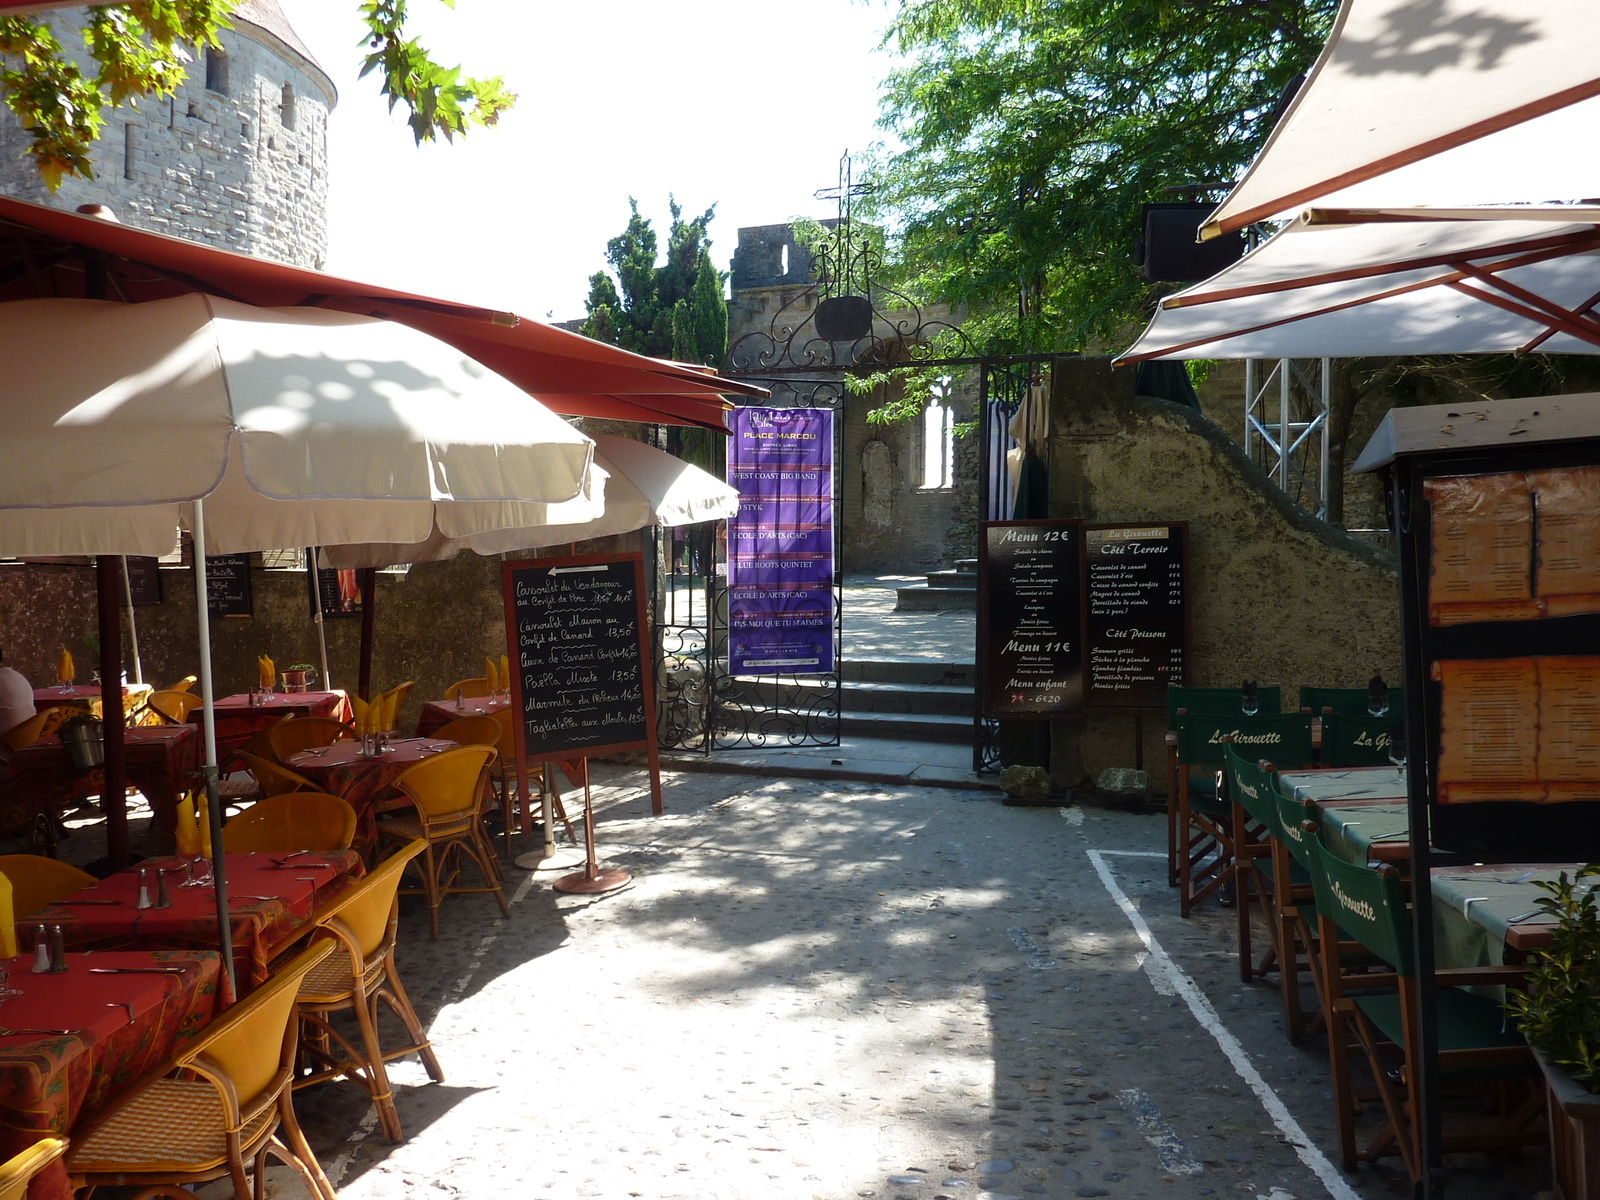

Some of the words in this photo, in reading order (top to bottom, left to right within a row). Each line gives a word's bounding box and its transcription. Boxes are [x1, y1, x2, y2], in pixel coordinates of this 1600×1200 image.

[787, 532, 807, 540] (CAC)
[999, 530, 1038, 545] Menu
[1108, 529, 1120, 538] La
[1123, 529, 1163, 539] Girouette
[1101, 544, 1125, 555] Côté
[1127, 543, 1168, 555] Terroir
[780, 561, 813, 569] QUINTET
[517, 579, 559, 597] Cassoulet
[561, 581, 572, 592] du
[1139, 581, 1159, 589] confite
[532, 596, 556, 609] Confit
[558, 594, 567, 603] de
[734, 591, 758, 599] ÉCOLE
[520, 616, 562, 633] Cassoulet
[569, 615, 602, 627] Maison
[606, 617, 620, 625] au
[764, 620, 780, 628] QUE
[792, 619, 824, 627] M'AIMES
[520, 636, 546, 649] Confit
[548, 632, 559, 642] de
[561, 628, 593, 640] Canard
[1106, 629, 1128, 638] Côté
[1129, 628, 1166, 640] Poissons
[1001, 639, 1040, 655] Menu
[1045, 642, 1070, 652] 11€
[548, 652, 559, 663] de
[561, 649, 594, 663] Canard
[1117, 665, 1142, 673] flambées
[525, 673, 560, 689] Paëlla
[567, 671, 598, 685] Mixte
[1005, 678, 1033, 690] Menu
[1036, 679, 1067, 691] enfant
[526, 694, 573, 712] Marmite
[578, 695, 590, 705] du
[1353, 731, 1373, 746] La
